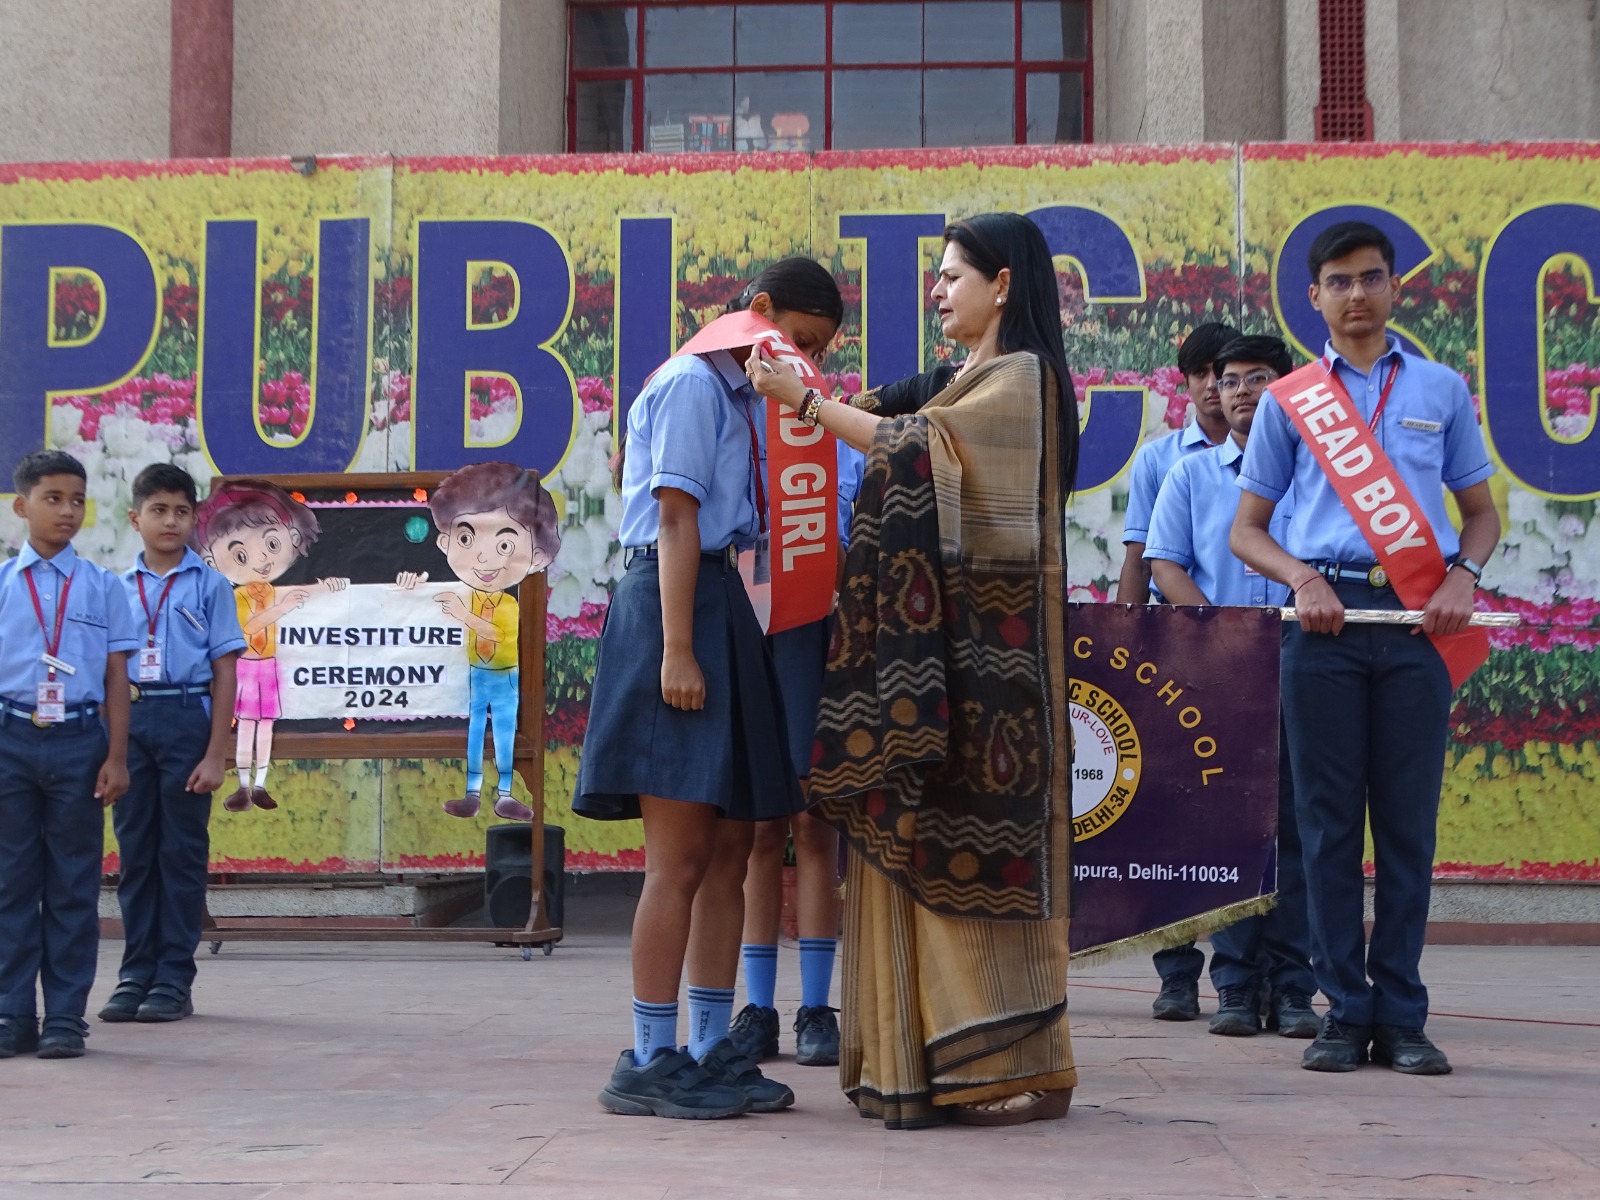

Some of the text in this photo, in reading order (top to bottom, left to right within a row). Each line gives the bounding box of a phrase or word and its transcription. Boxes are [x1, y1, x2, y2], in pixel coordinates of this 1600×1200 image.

[1289, 382, 1427, 556] HEAD BOY
[780, 462, 827, 572] GIRL
[280, 626, 462, 646] INVESTITURE
[293, 665, 445, 686] CEREMONY
[344, 689, 409, 708] 2024
[1109, 647, 1224, 786] SCHOOL
[1085, 689, 1138, 763] SCHOOL
[1074, 769, 1104, 781] 1968
[1073, 786, 1130, 837] DELHI-34
[1129, 863, 1239, 884] Delhi-110034
